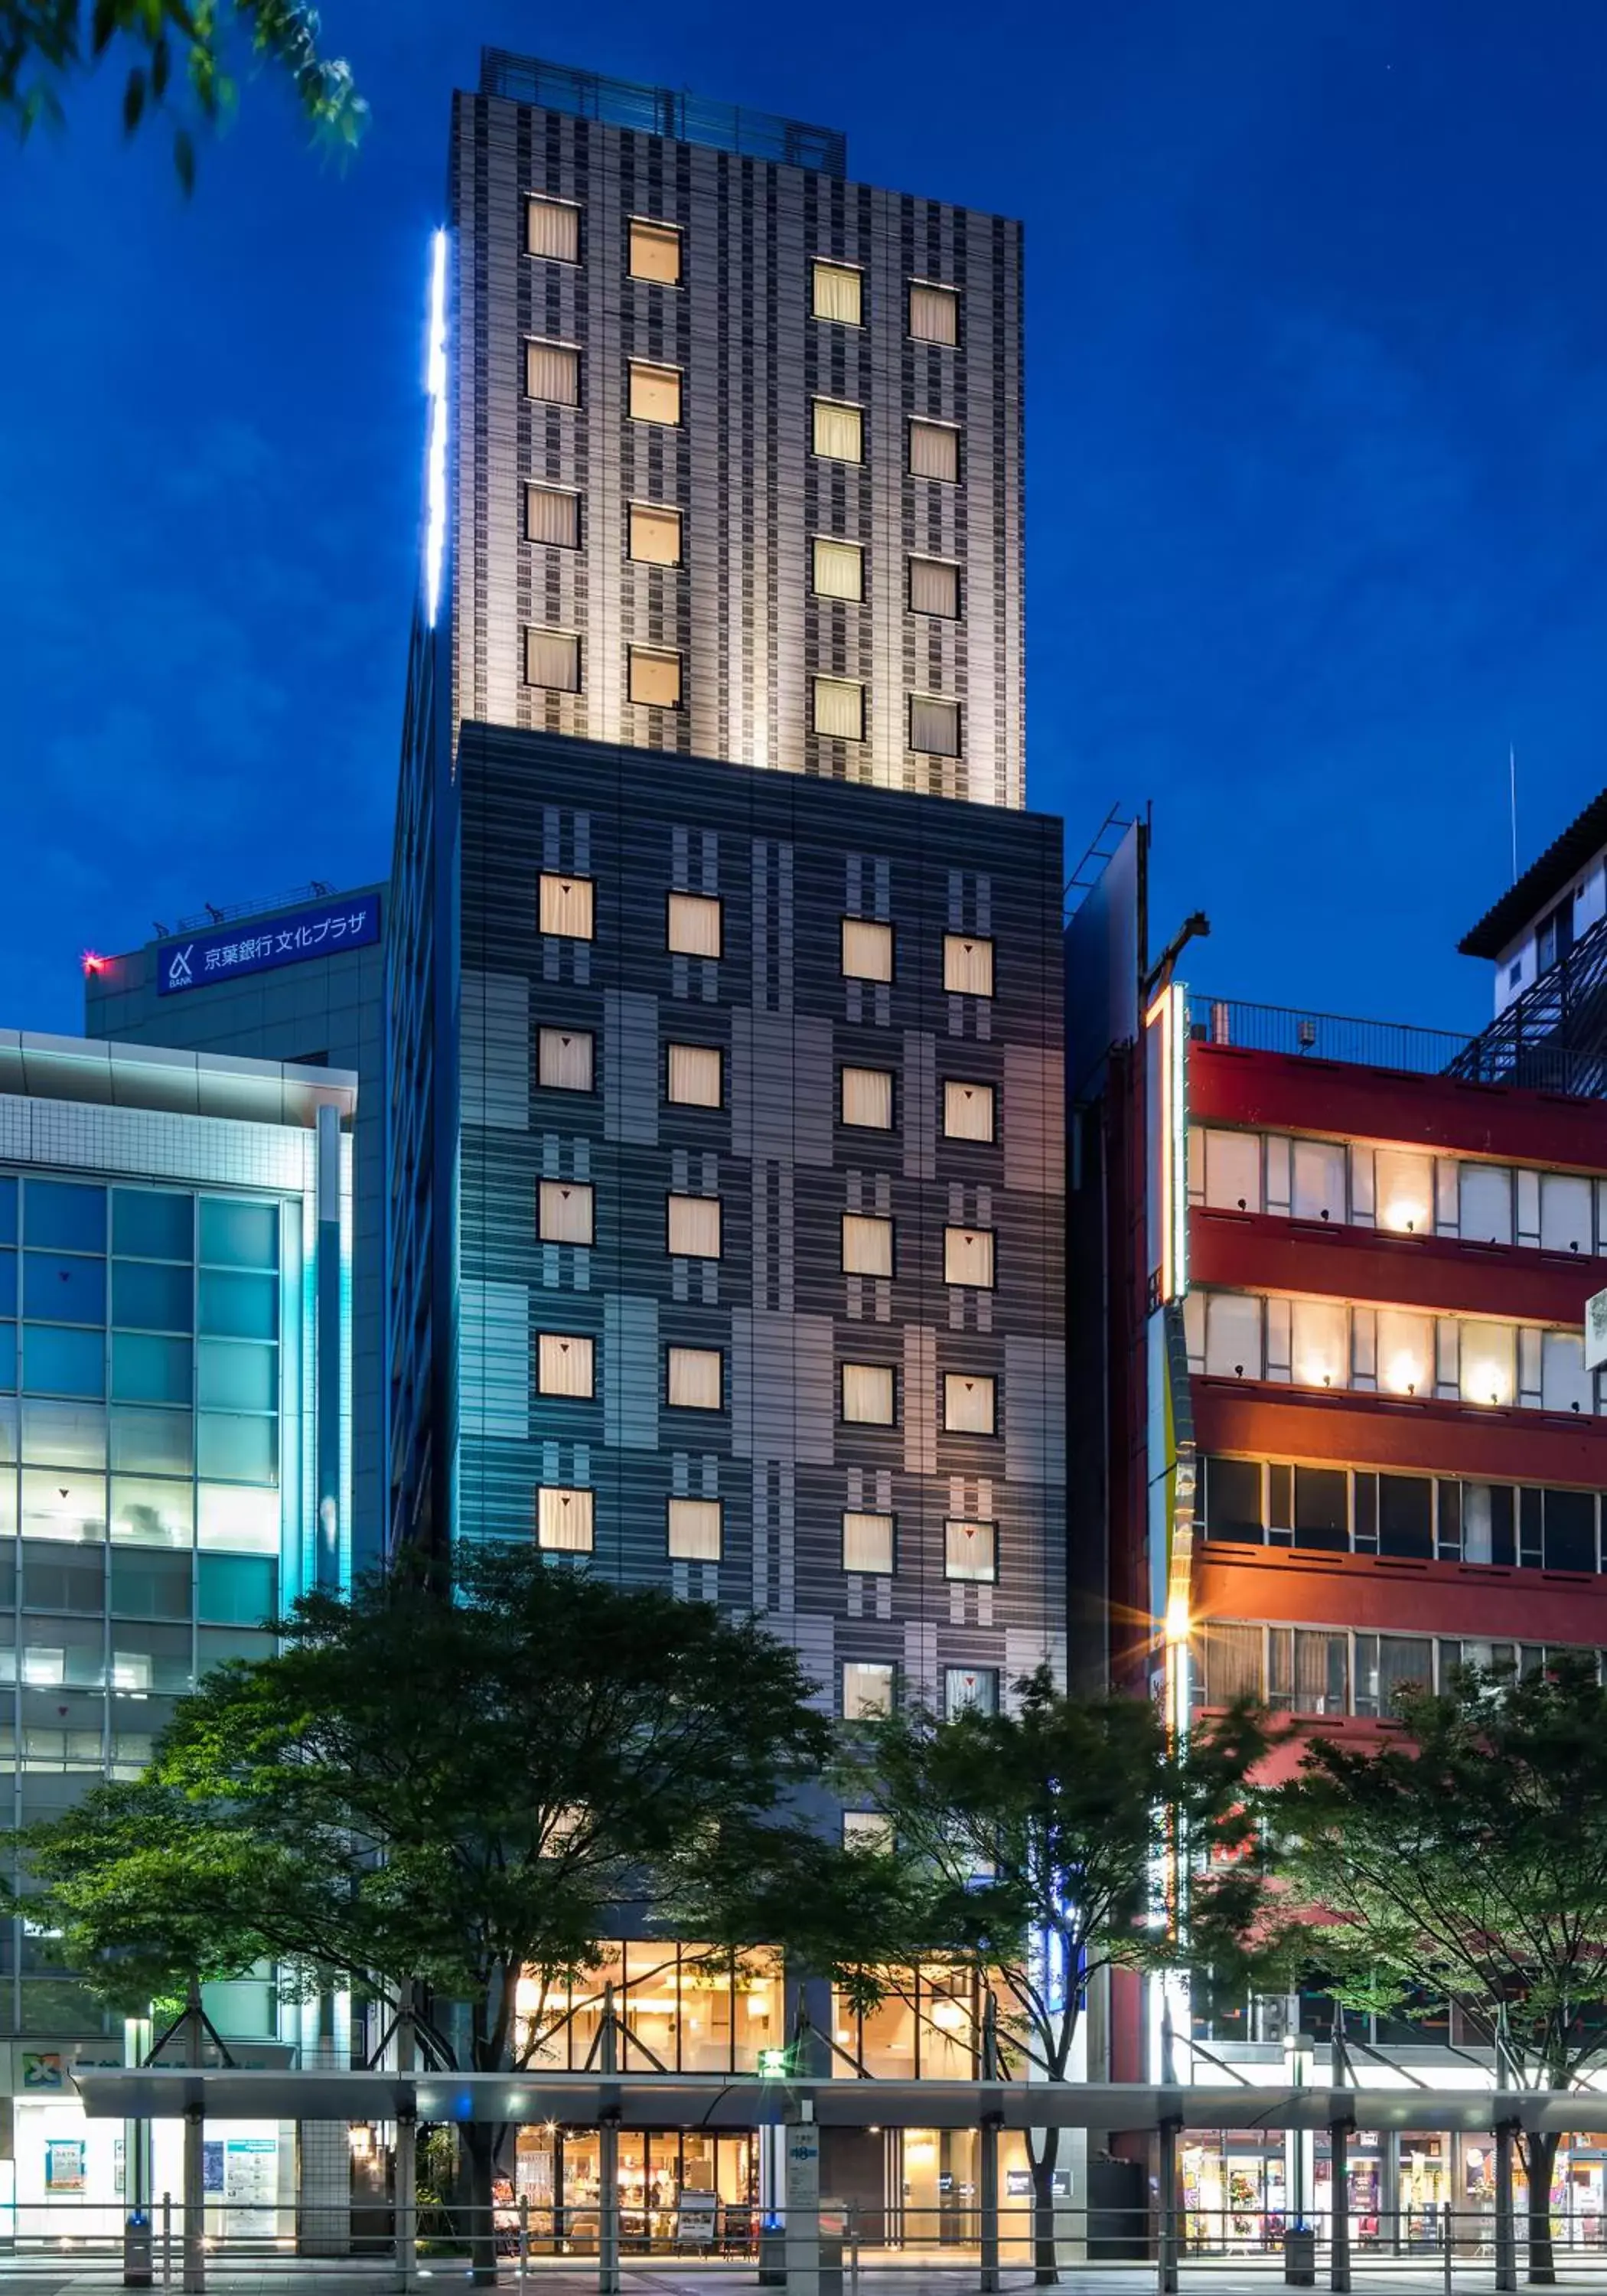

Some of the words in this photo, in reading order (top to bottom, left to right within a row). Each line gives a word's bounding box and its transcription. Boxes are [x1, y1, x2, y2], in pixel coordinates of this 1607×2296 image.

[204, 911, 366, 970] 京葉銀行文化プラザ
[169, 977, 192, 988] BANK
